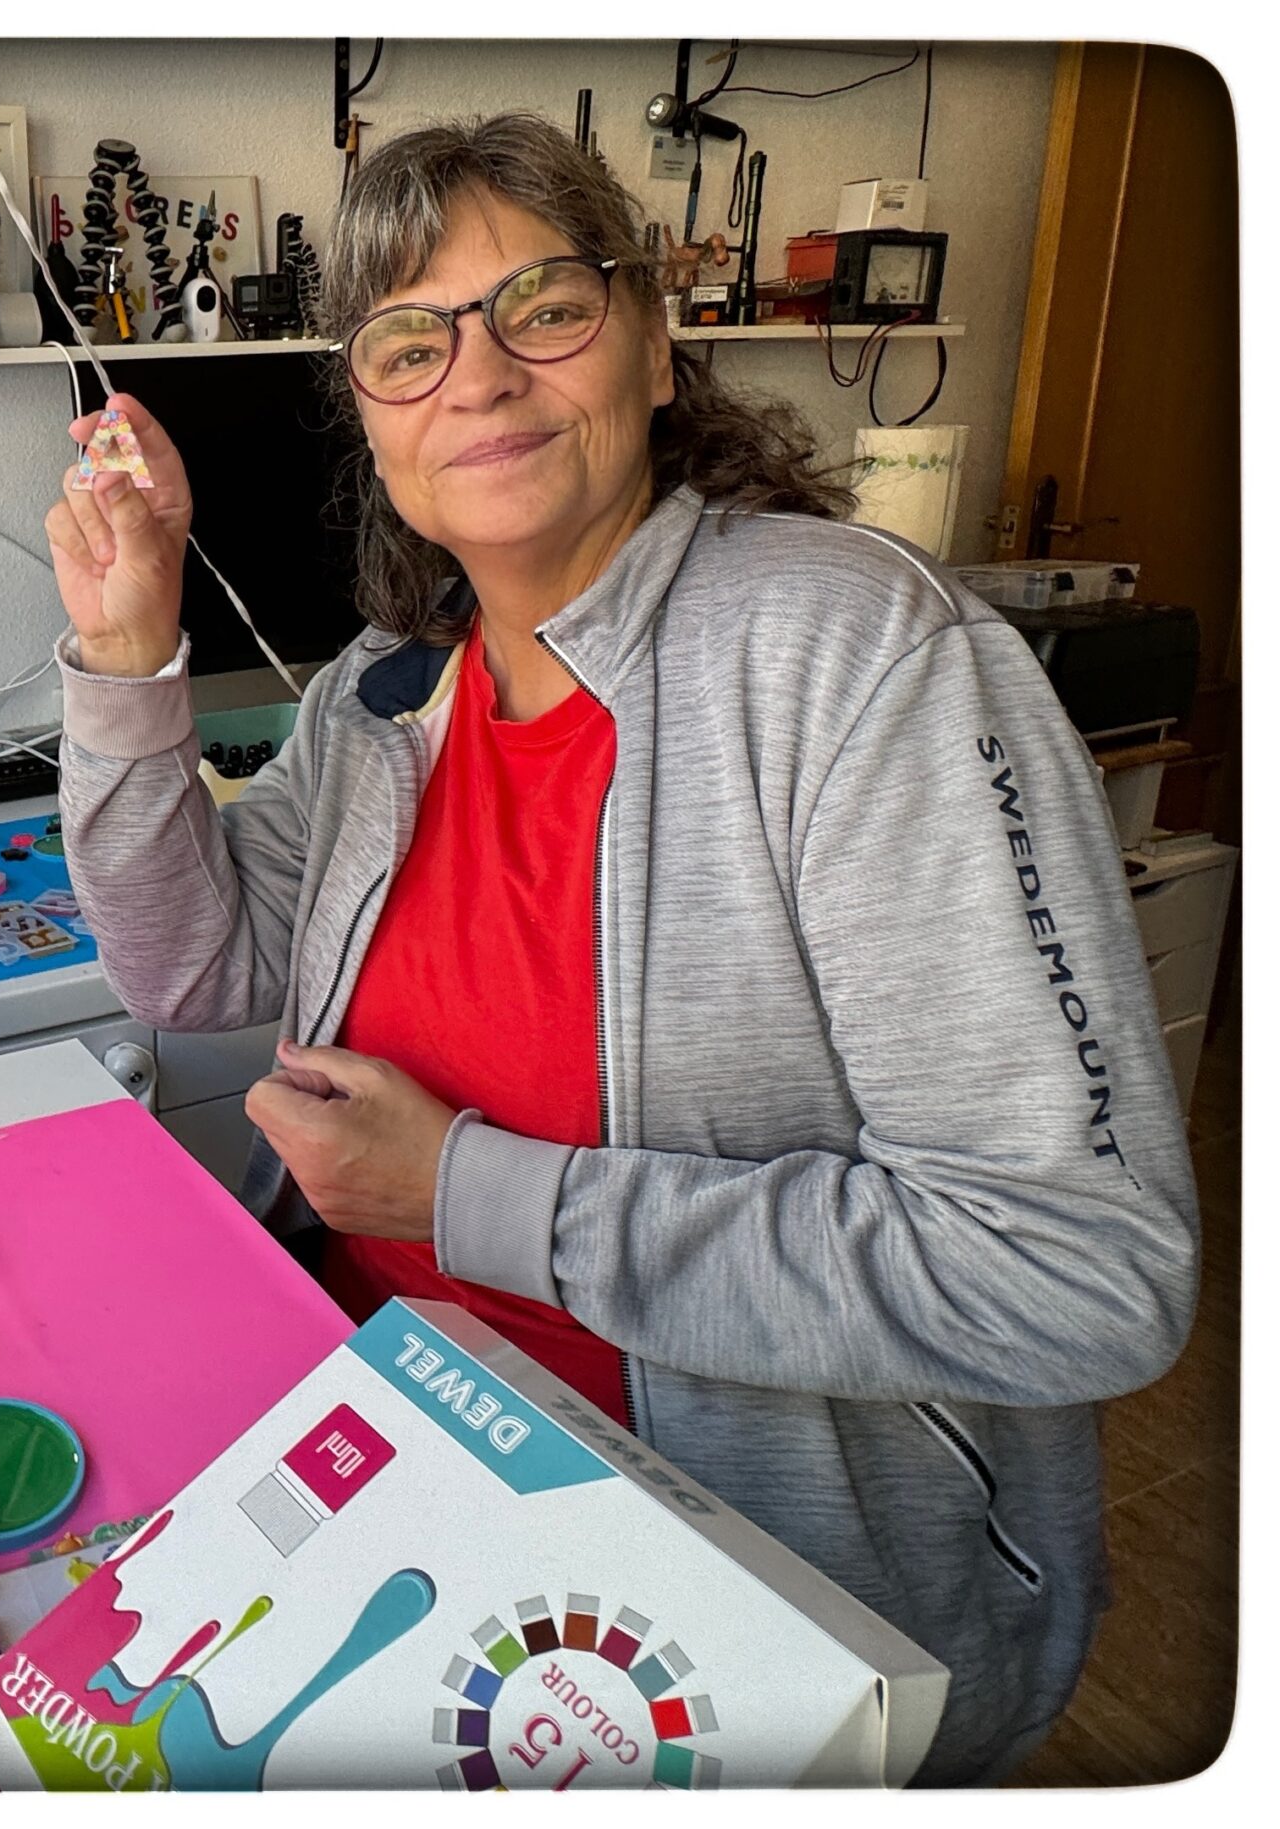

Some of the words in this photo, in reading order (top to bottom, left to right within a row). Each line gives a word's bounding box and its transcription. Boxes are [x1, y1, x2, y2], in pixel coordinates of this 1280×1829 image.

[393, 1332, 531, 1455] DEWEL
[314, 1428, 369, 1480] 10ml
[1, 1653, 143, 1792] POWDER
[541, 1661, 640, 1765] COLOUR
